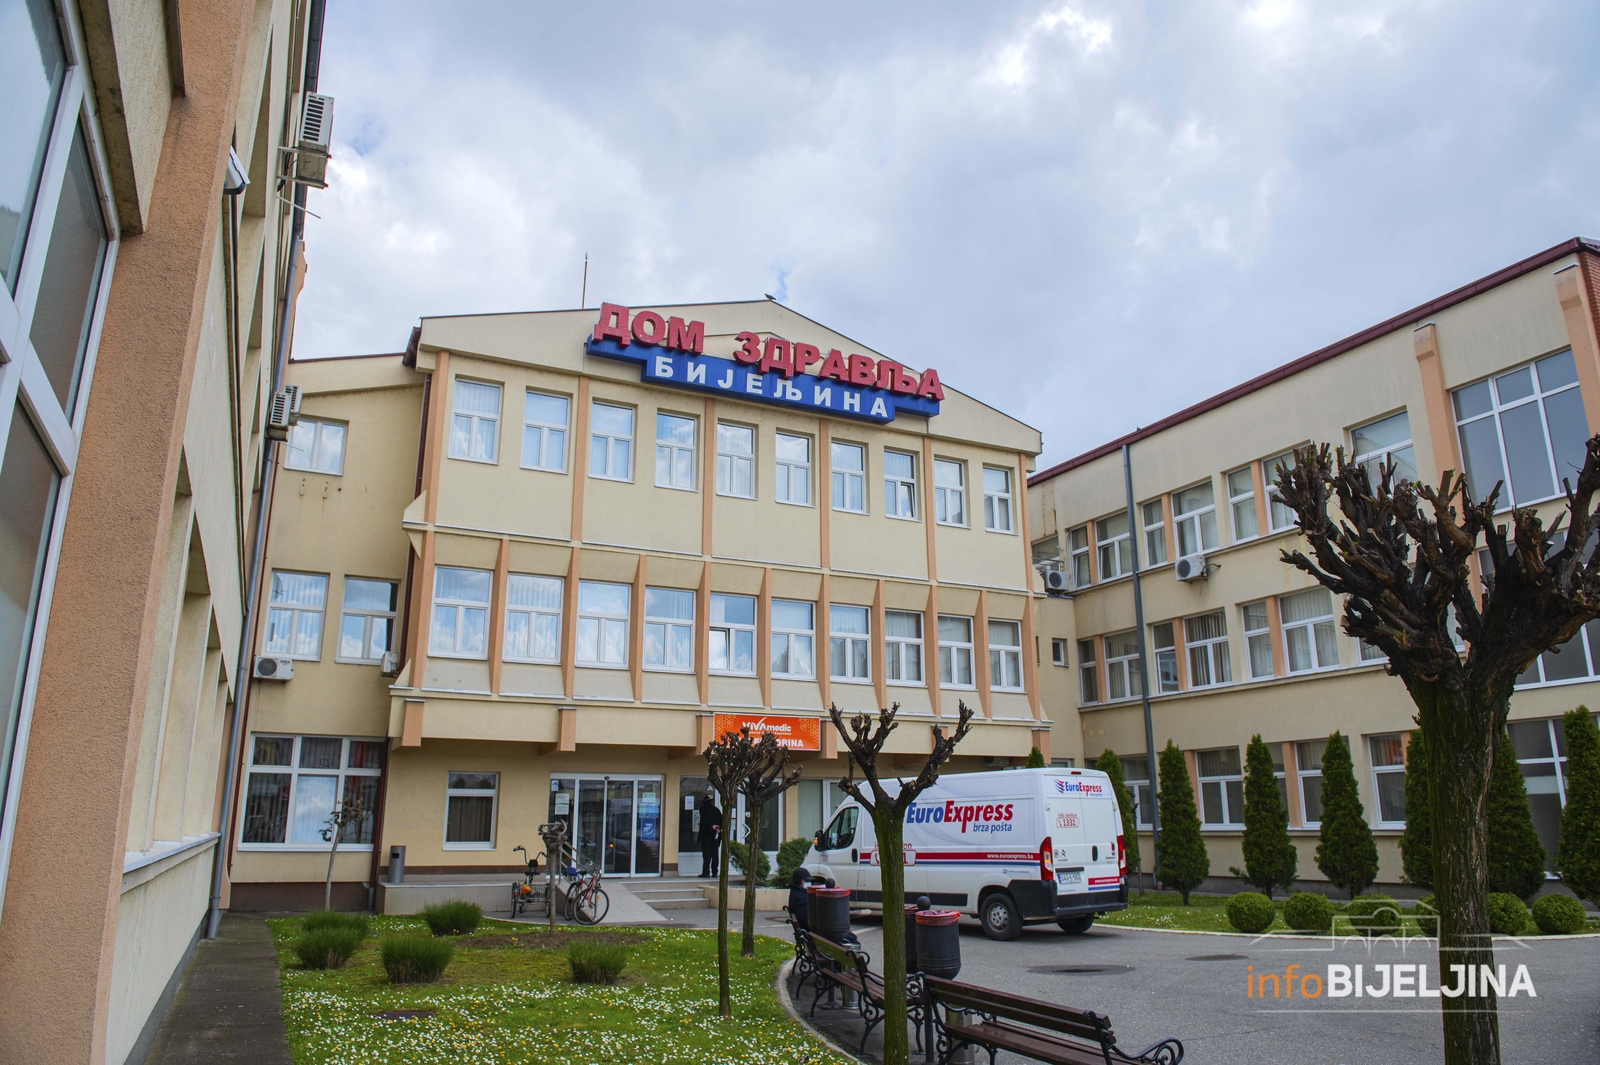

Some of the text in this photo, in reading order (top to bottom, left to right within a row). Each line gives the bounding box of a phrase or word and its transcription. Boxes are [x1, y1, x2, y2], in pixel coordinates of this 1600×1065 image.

[592, 301, 945, 401] ДОМ ЗДРАВЉА
[655, 355, 888, 418] БИЈЕЉИНА
[1065, 781, 1102, 797] EuroExpress
[906, 800, 1014, 833] EuroExpress
[973, 822, 1012, 834] brza pošta
